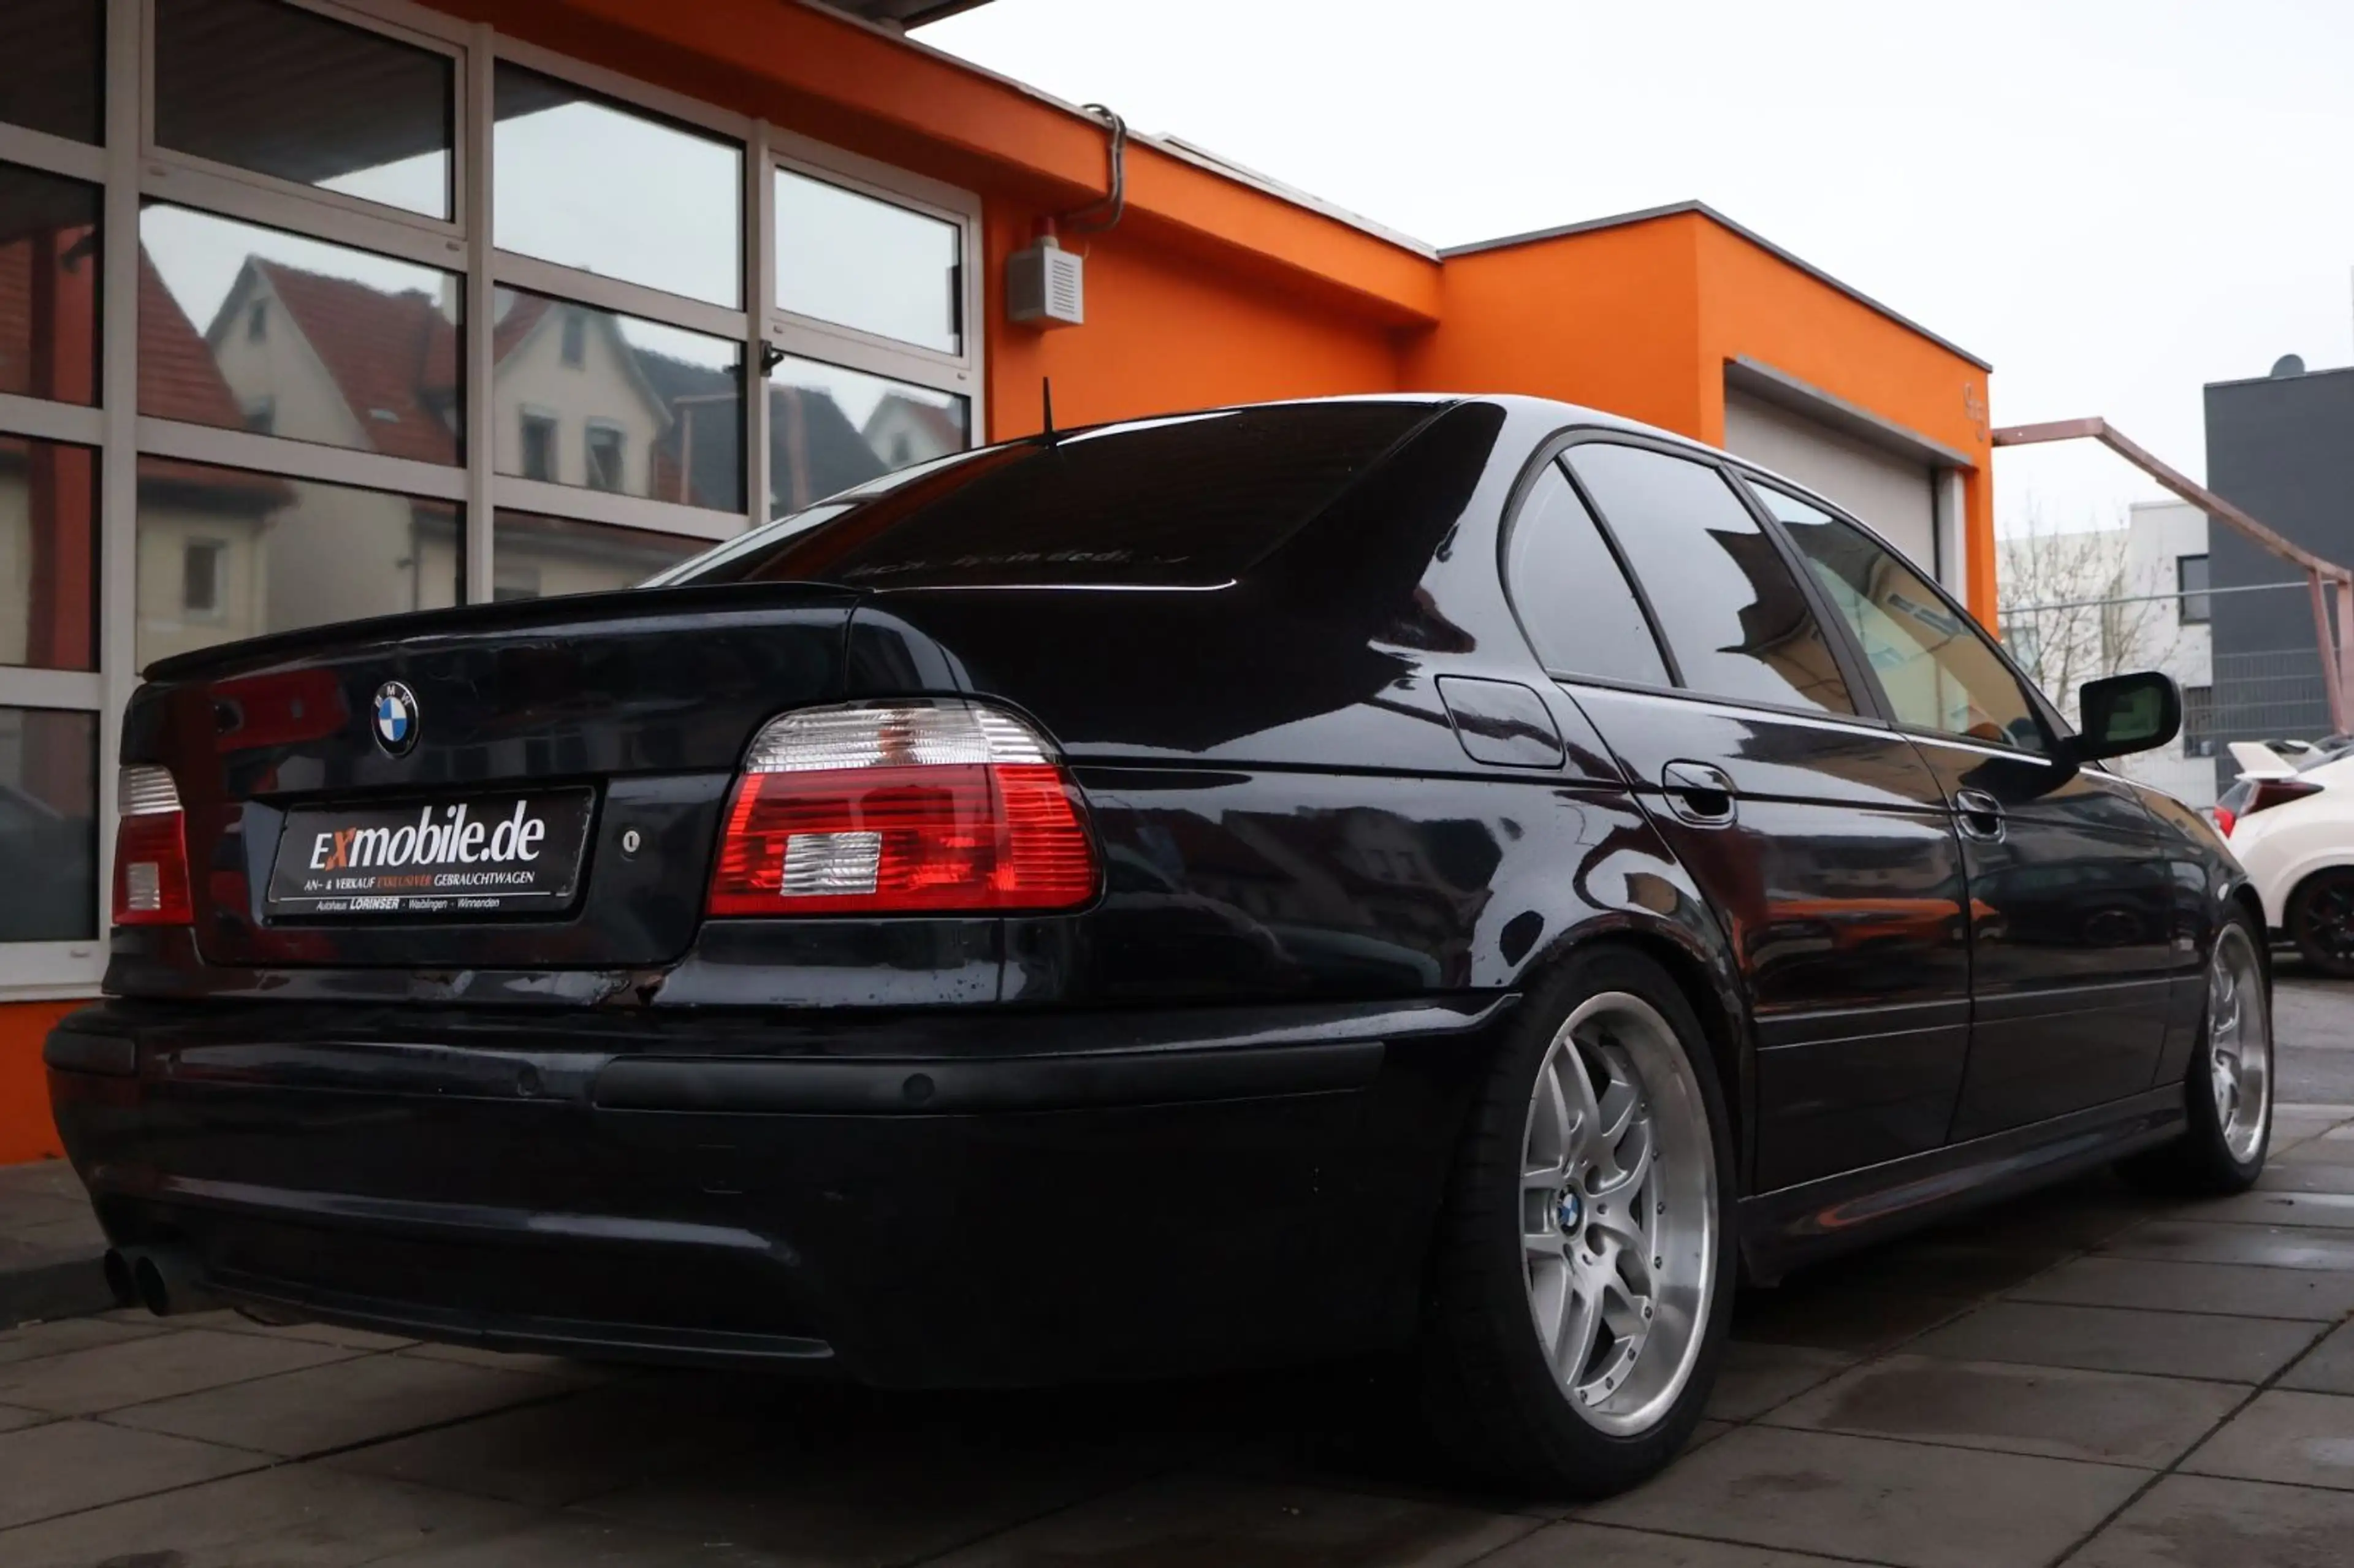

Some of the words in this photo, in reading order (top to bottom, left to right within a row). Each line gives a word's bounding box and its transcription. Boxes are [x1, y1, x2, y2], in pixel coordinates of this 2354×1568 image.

[375, 684, 412, 709] BMW
[310, 800, 546, 871] EXmobile.de
[335, 876, 376, 889] VERKAUF
[434, 871, 535, 886] GEBRAUCHTWAGEN
[349, 897, 400, 910] LORINSER
[408, 898, 448, 911] Waiblingen
[457, 897, 500, 908] Winnenden
